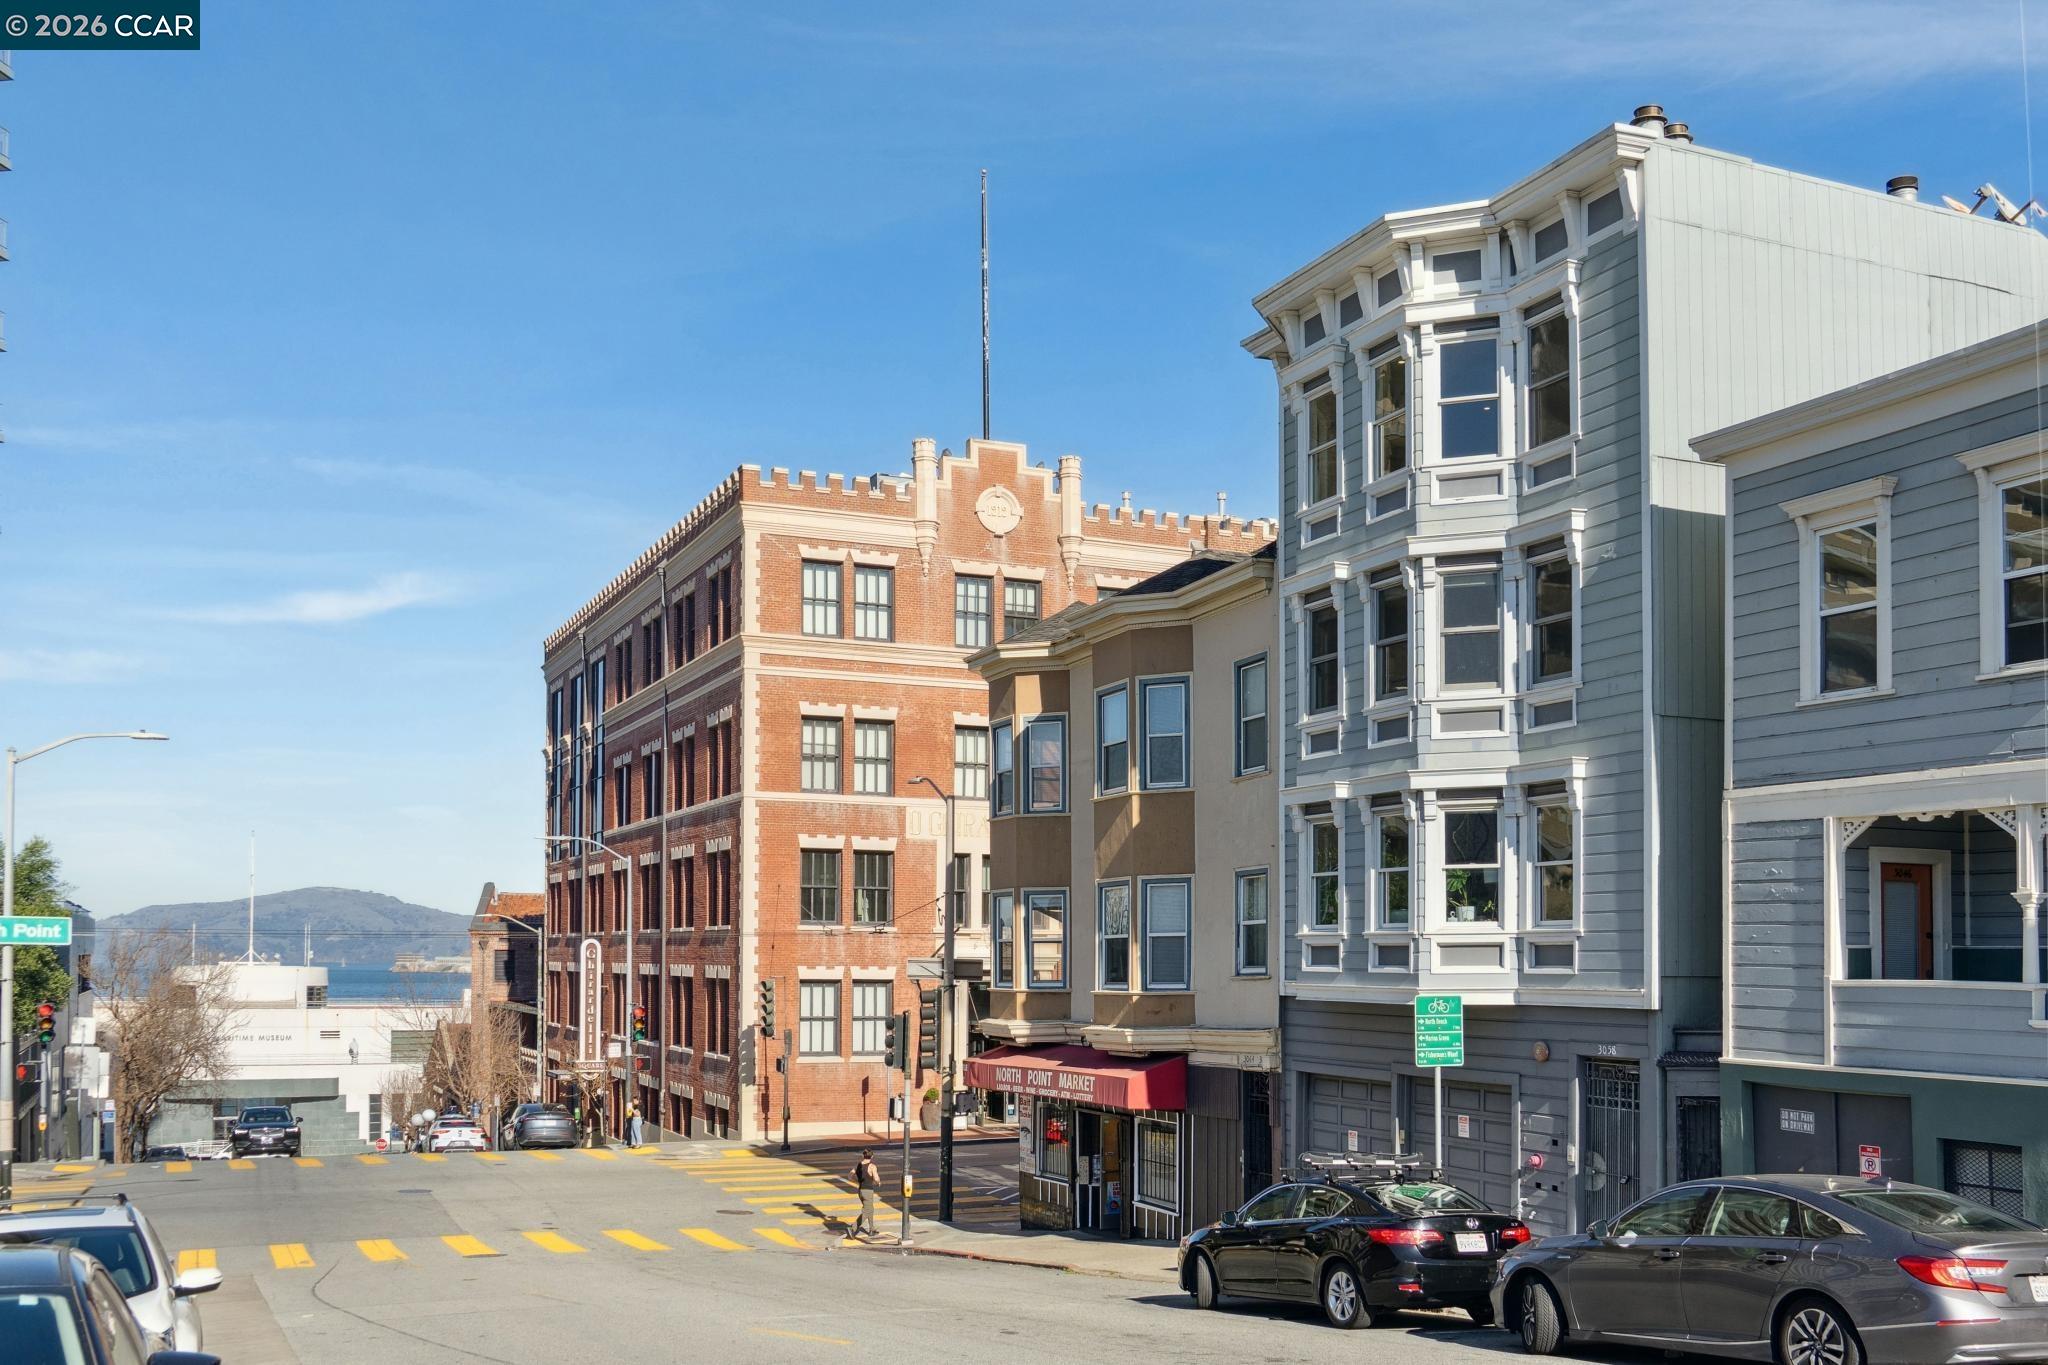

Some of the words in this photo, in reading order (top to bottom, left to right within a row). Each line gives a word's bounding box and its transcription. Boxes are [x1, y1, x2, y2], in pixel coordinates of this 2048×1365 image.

[13, 923, 62, 938] Point
[1598, 1045, 1617, 1055] 3058
[996, 1067, 1022, 1083] NORTH
[1027, 1070, 1053, 1087] POINT
[1058, 1073, 1096, 1092] MARKET
[1012, 1085, 1024, 1093] BEER
[1039, 1088, 1058, 1098] GROCERY
[1060, 1091, 1071, 1099] ATM
[1073, 1093, 1094, 1102] LOTTERY
[1780, 1110, 1789, 1120] DO
[1790, 1111, 1799, 1121] NOT
[1800, 1112, 1813, 1122] PARK
[1780, 1119, 1789, 1129] ON
[1789, 1120, 1813, 1132] DRIVEWAY
